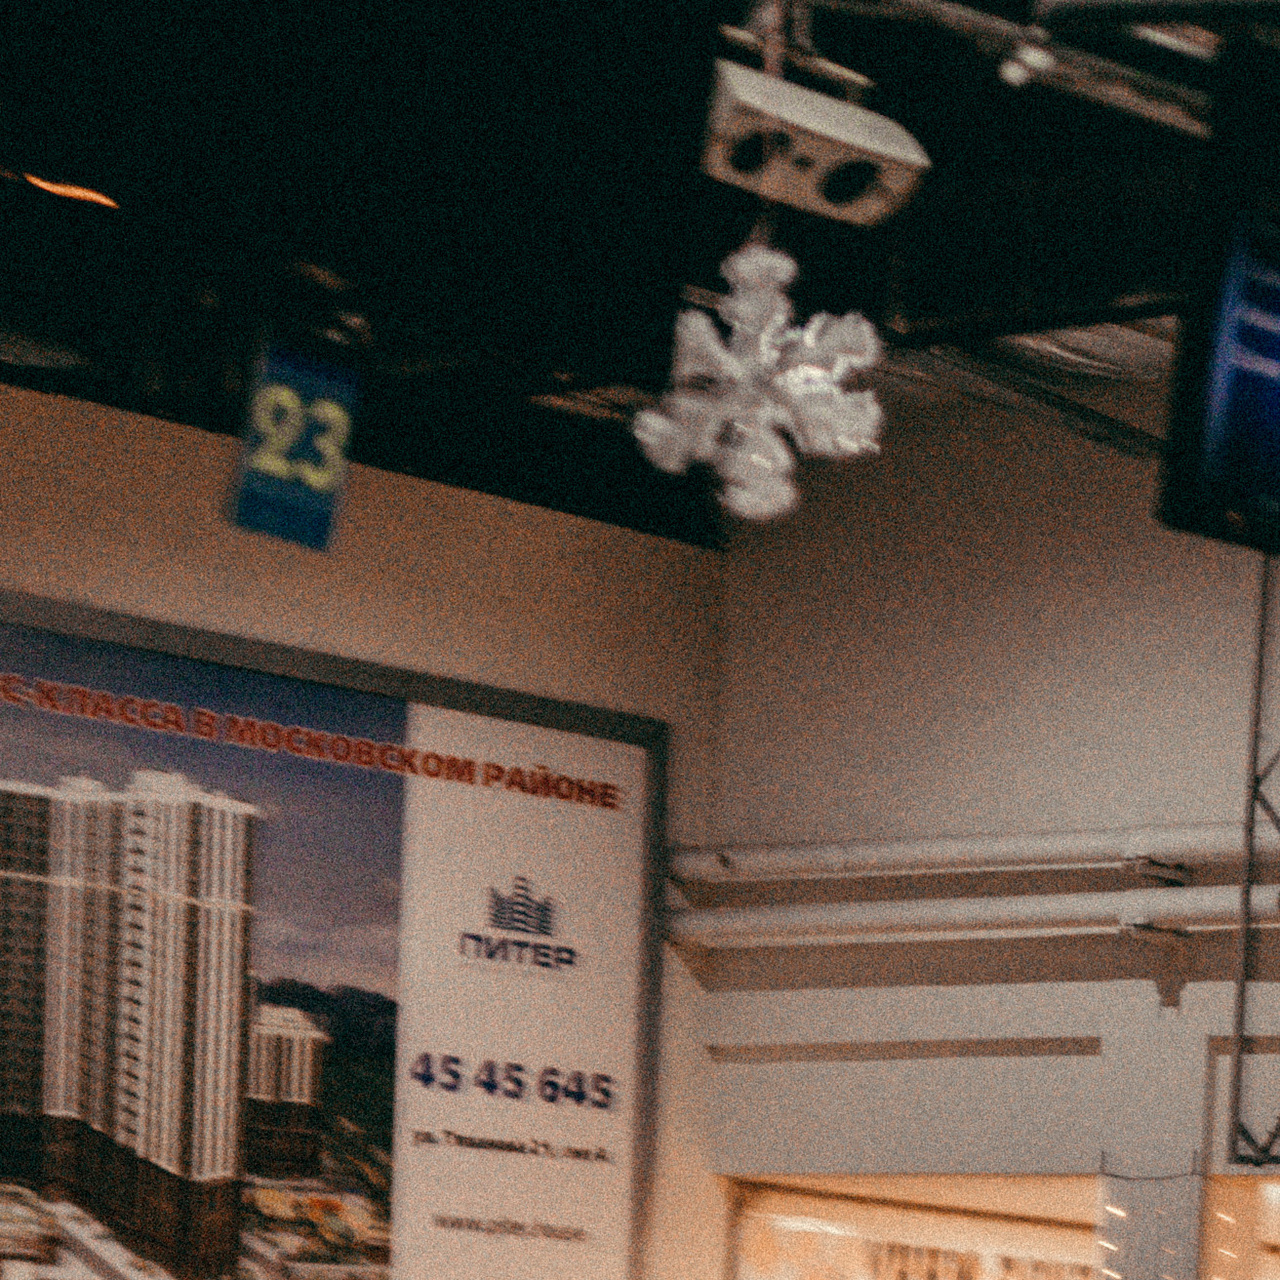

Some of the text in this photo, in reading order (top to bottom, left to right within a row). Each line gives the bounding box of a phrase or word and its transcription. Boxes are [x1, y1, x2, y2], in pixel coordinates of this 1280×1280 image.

[248, 382, 352, 494] 23
[194, 707, 219, 740] В
[225, 714, 476, 788] МОСКОВСКОМ
[482, 762, 622, 812] РАЙОНЕ
[460, 931, 579, 972] ПИТЕР
[409, 1050, 615, 1111] 45 45 645
